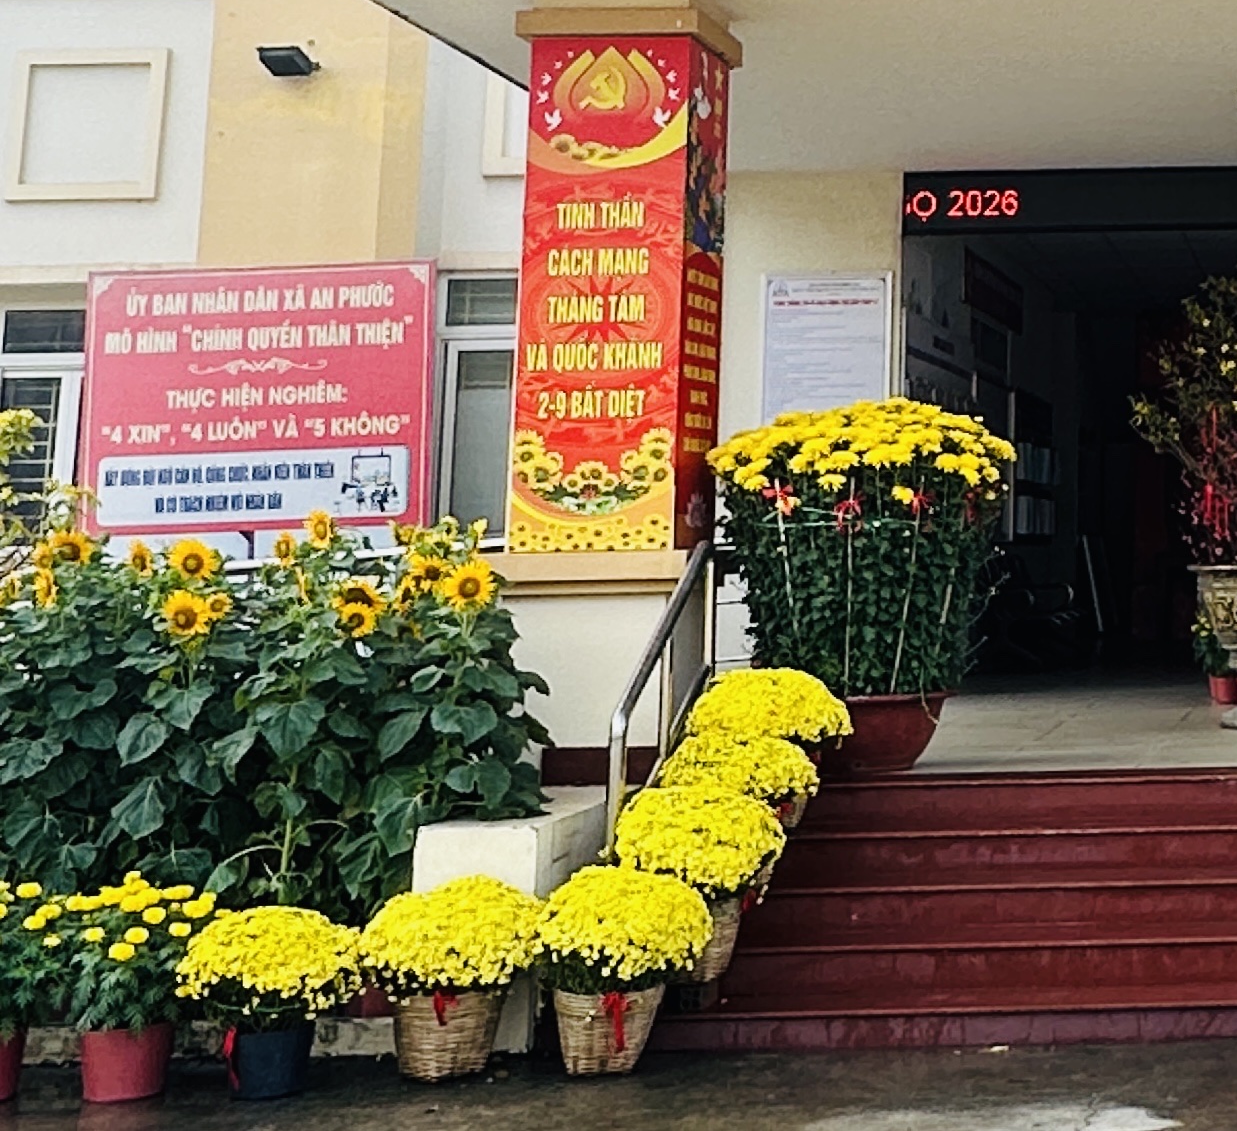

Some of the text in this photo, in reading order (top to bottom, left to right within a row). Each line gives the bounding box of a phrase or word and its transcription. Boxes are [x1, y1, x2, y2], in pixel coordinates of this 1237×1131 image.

[557, 202, 596, 229] TINH
[946, 189, 1019, 216] 2026
[548, 244, 593, 276] CÁCH
[598, 247, 650, 281] MẠNG
[151, 292, 189, 316] BAN
[191, 285, 240, 315] NHÂN
[243, 285, 279, 312] DÂN
[309, 286, 334, 310] AN
[338, 279, 395, 309] PHƯỚC
[547, 290, 645, 324] THÁNG TÁM
[104, 327, 133, 354] MÔ
[136, 325, 178, 353] HÌNH
[306, 319, 351, 346] THÂN
[603, 338, 663, 370] KHÁNH
[166, 386, 217, 414] THỰC
[220, 381, 264, 413] HIỆN
[537, 390, 567, 420] 2-9
[570, 380, 604, 419] BẤT
[608, 383, 646, 424] DIỆT
[272, 413, 299, 439] VÀ
